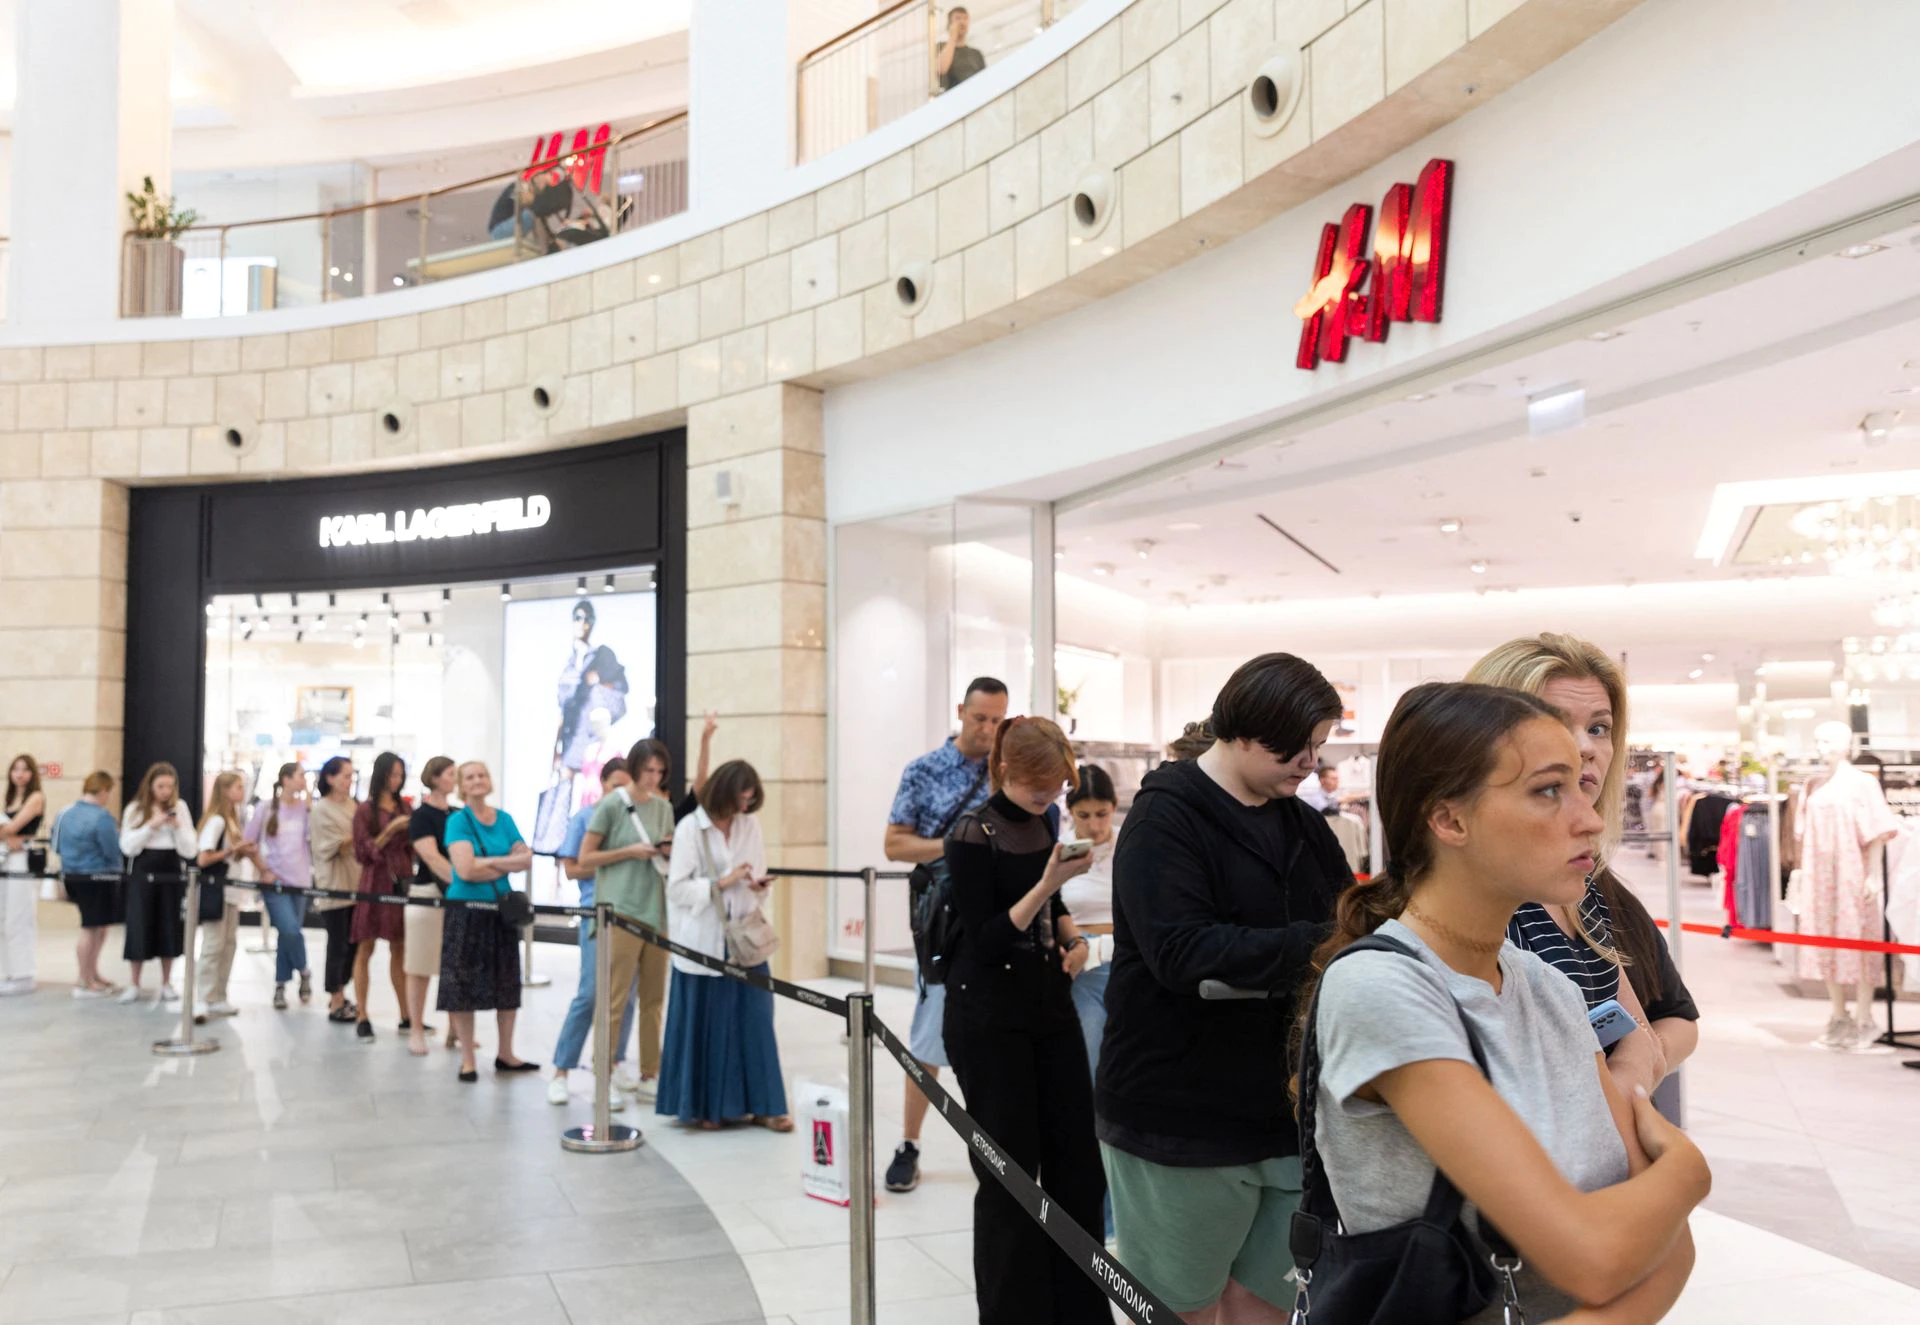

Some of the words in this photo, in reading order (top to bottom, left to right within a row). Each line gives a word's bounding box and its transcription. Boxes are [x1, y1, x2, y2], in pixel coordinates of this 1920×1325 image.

[1293, 158, 1454, 371] H&M
[318, 512, 395, 548] KARL
[394, 494, 551, 542] LAGERFELD
[1091, 1251, 1154, 1325] МЕТРОПОЛИС
